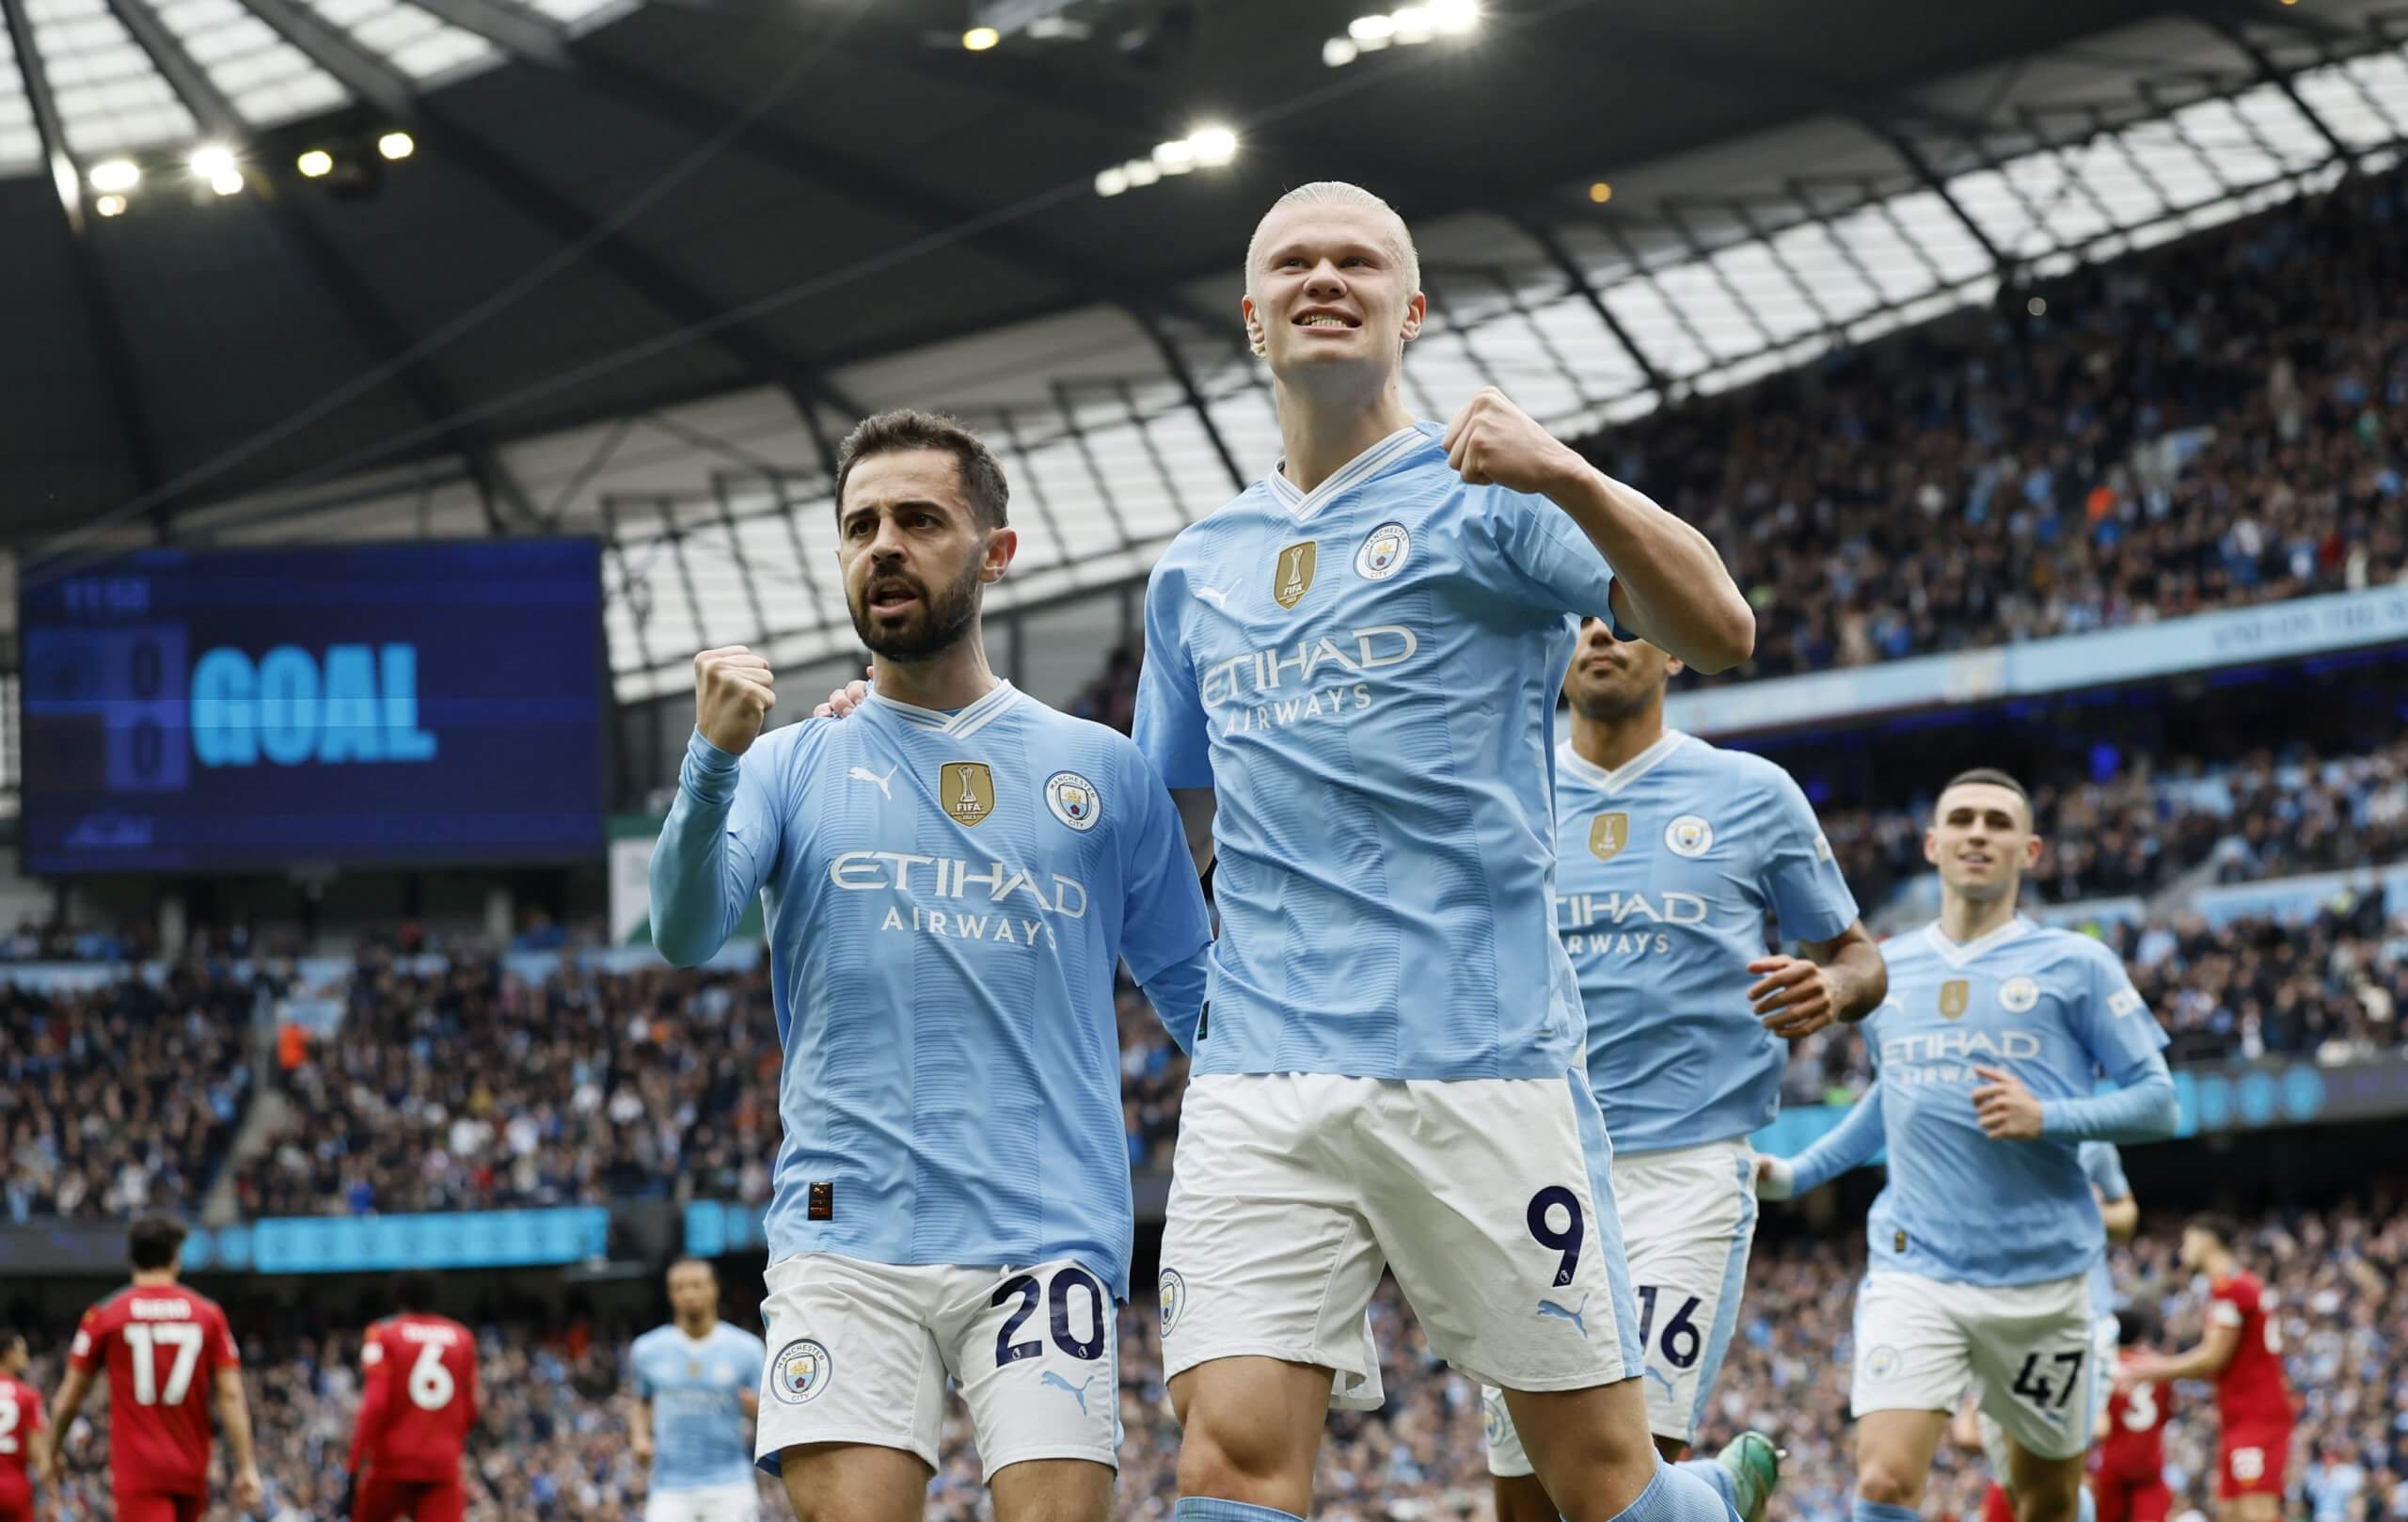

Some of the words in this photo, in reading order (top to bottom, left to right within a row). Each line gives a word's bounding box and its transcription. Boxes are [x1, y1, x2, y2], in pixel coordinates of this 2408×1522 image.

[1283, 584, 1302, 595] FIFA
[1370, 570, 1387, 579] CITY
[1202, 625, 1418, 708] ETIHAD
[191, 642, 436, 767] GOAL
[1223, 684, 1371, 738] AIRWAYS
[956, 803, 981, 813] FIFA
[1068, 818, 1085, 828] CITY
[830, 850, 1086, 918] ETIHAD
[1556, 892, 1707, 927] IHAD
[880, 906, 1057, 949] AIRWAYS
[1568, 933, 1671, 955] RWAYS
[1881, 1031, 2040, 1066] ETIHAD
[1527, 1185, 1584, 1287] 9
[991, 1268, 1104, 1368] 20
[1639, 1285, 1701, 1369] 16
[123, 1322, 203, 1405] 17
[407, 1340, 455, 1411] 6
[777, 1345, 825, 1369] MANCHESTER
[2013, 1350, 2084, 1408] 47
